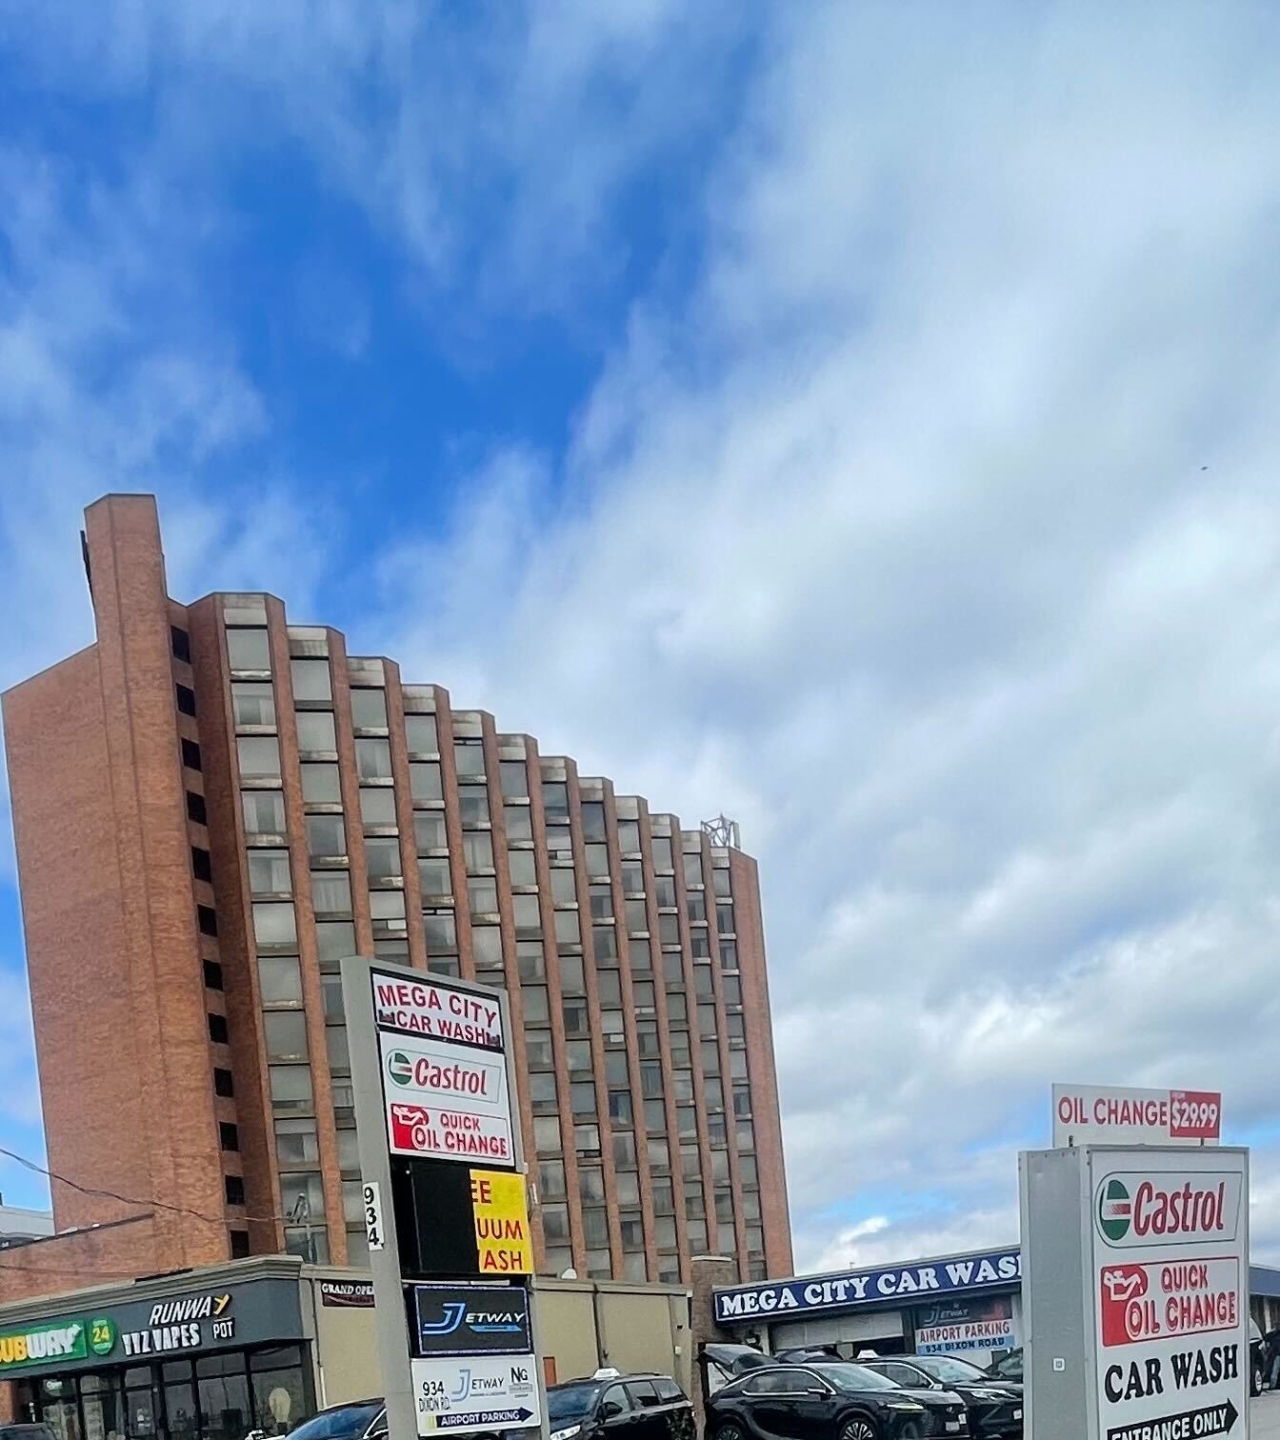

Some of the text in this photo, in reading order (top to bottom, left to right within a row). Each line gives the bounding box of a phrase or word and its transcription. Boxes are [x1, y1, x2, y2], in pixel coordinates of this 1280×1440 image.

[377, 985, 497, 1028] MEGA CITY
[396, 1010, 485, 1045] CAR WASH
[415, 1057, 487, 1096] Castrol
[440, 1113, 481, 1132] QUICK
[1058, 1096, 1218, 1130] OIL CHANGE $29.99
[414, 1126, 507, 1156] OIL CHANGE
[363, 1186, 380, 1246] 934
[1134, 1180, 1226, 1236] Castrol
[477, 1249, 523, 1271] ASH
[321, 1283, 374, 1295] GRAND OPE
[721, 1289, 798, 1316] MEGA
[803, 1276, 870, 1304] CITY
[876, 1267, 939, 1295] CAR
[1161, 1264, 1208, 1294] QUICK
[149, 1293, 230, 1326] RUNWAY
[1128, 1291, 1235, 1337] OIL CHANGE
[92, 1326, 110, 1343] 24
[122, 1322, 233, 1356] YYZ VAPES POT
[920, 1321, 1010, 1343] AIRPORT PARKING
[945, 1340, 975, 1351] DIXON
[978, 1337, 1005, 1348] ROAD
[422, 1381, 444, 1396] 934
[1104, 1344, 1238, 1403] CAR WASH
[441, 1410, 520, 1427] AIRPORT PARKING
[1193, 1407, 1228, 1434] ONLY
